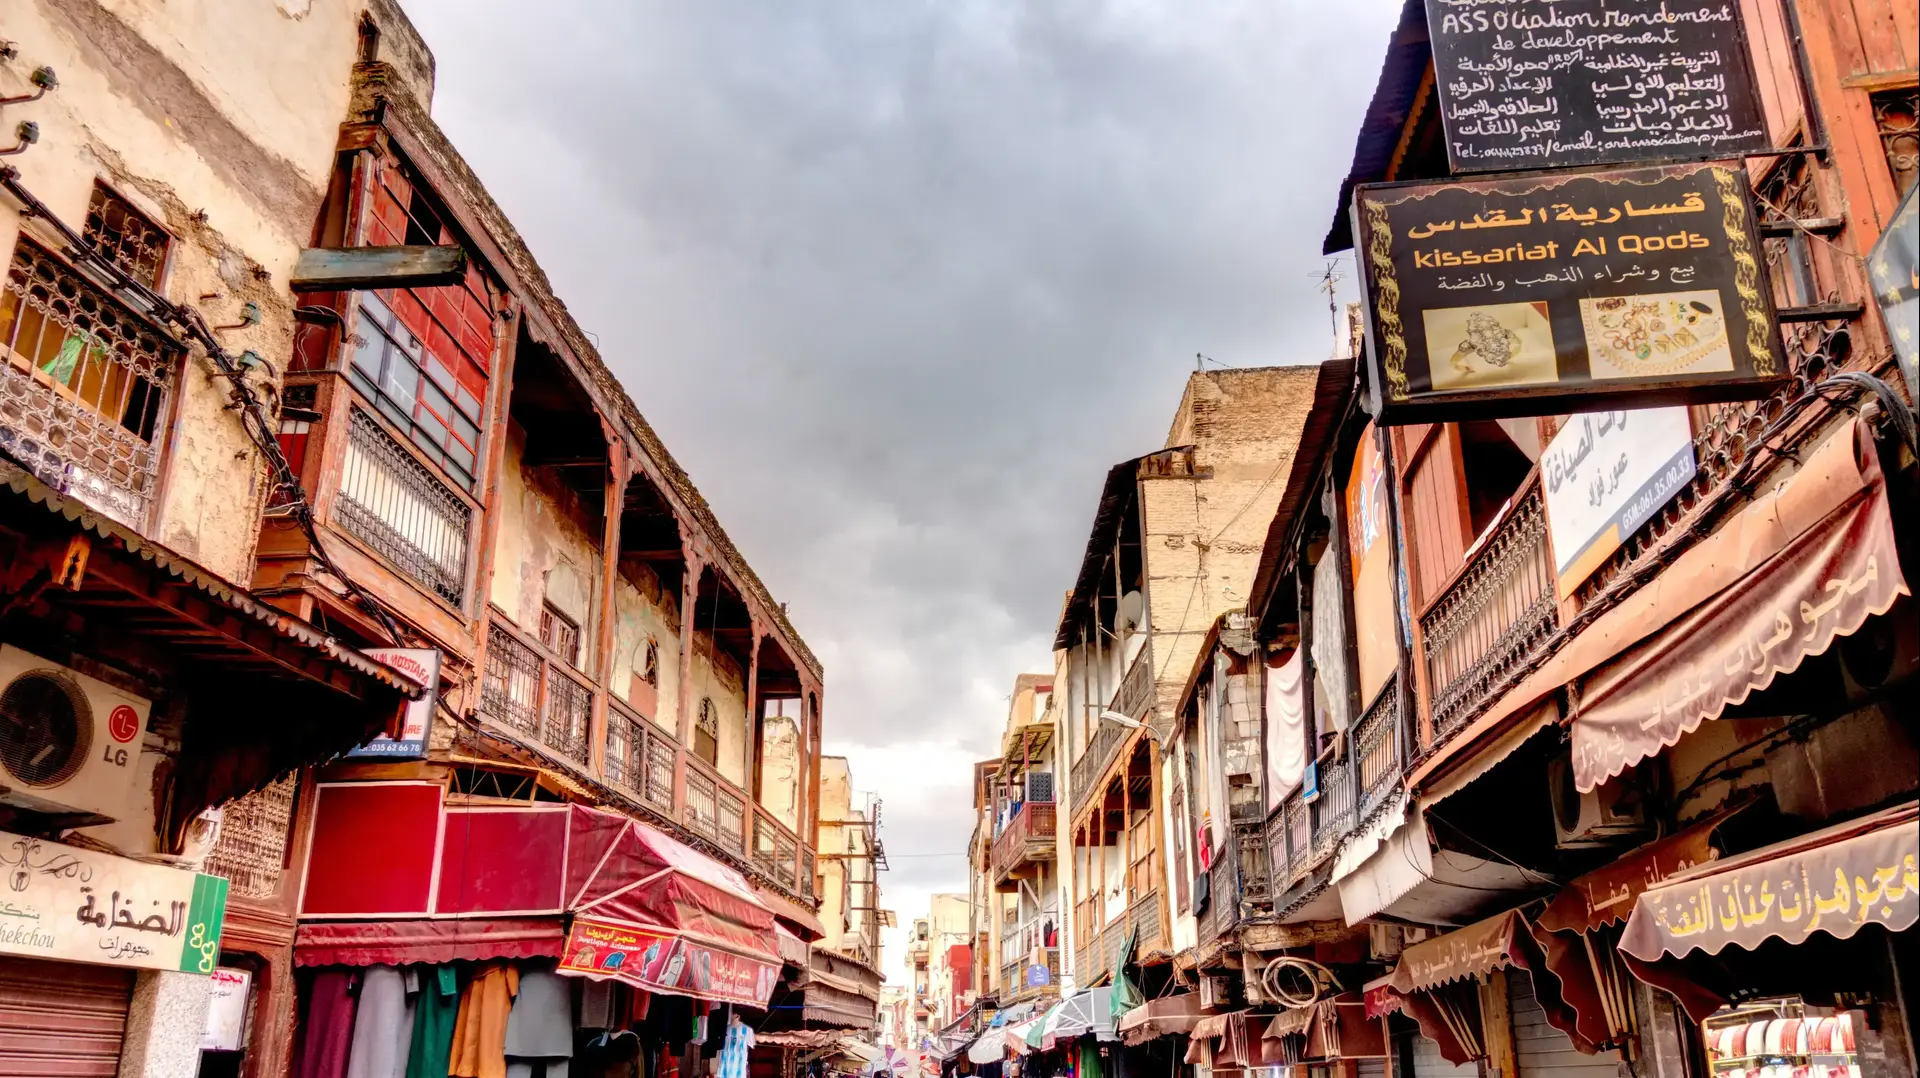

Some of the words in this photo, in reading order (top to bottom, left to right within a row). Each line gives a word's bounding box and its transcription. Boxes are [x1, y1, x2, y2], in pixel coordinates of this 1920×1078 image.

[1492, 34, 1516, 50] de
[1522, 28, 1679, 51] developpement
[1449, 76, 1495, 100] الحرفي
[1665, 74, 1725, 100] التعليم
[1459, 118, 1518, 135] اللغات
[1519, 118, 1561, 142] تعليم
[1555, 192, 1706, 227] قسارية
[1408, 207, 1548, 239] القدس
[1415, 240, 1560, 269] kissariat
[1571, 237, 1606, 258] Al
[1617, 229, 1710, 255] Qods
[1437, 272, 1505, 292] والفضة
[1515, 266, 1584, 286] الذهب
[1669, 264, 1695, 284] بيع
[103, 744, 128, 767] LG
[76, 886, 187, 937] الضخامة
[98, 936, 151, 959] مجوهرات
